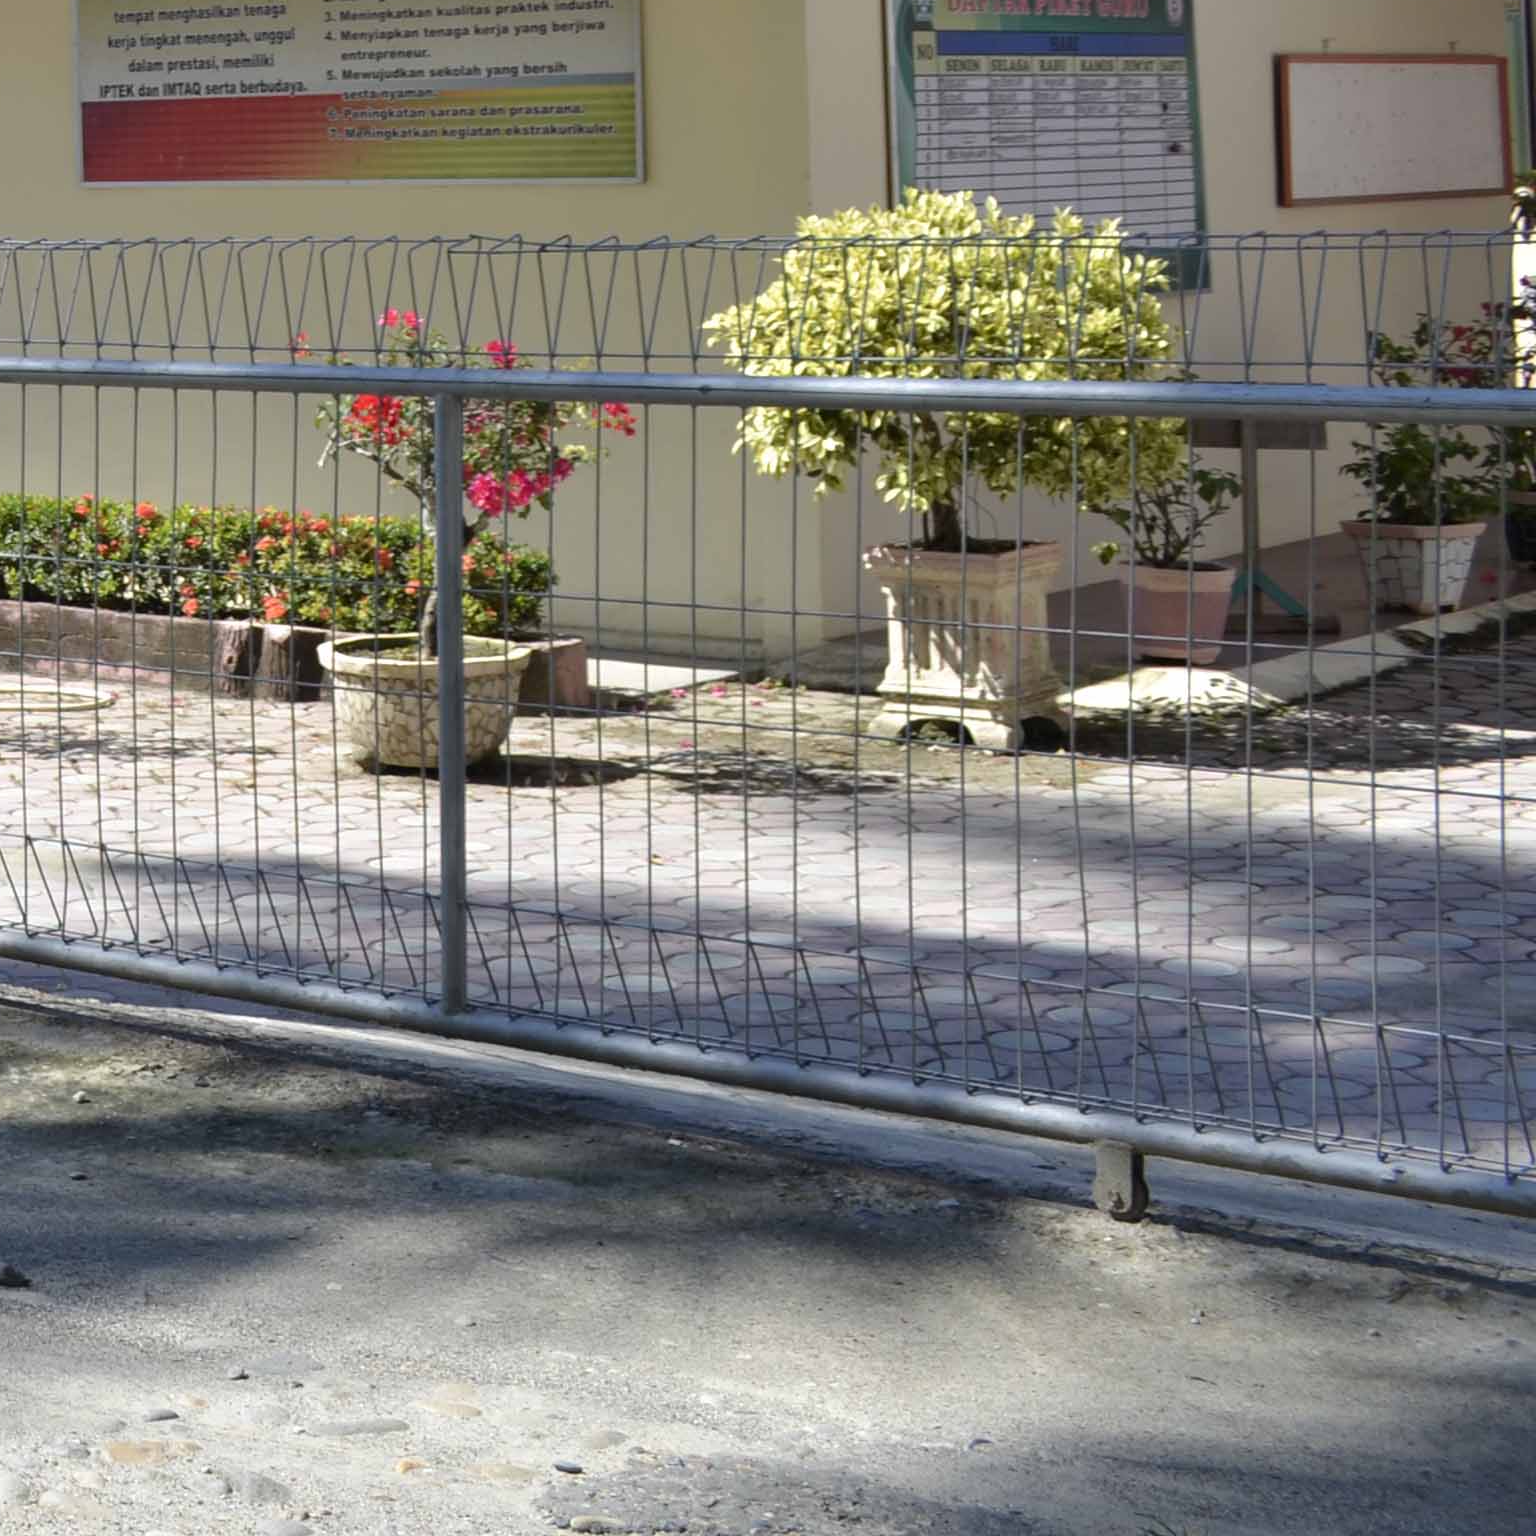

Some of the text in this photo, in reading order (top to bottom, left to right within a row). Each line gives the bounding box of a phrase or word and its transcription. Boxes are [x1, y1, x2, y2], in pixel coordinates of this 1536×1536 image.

[113, 2, 288, 25] tempat menghasilkan tenaga
[339, 7, 433, 24] Meningkatkan
[436, 3, 491, 16] kualitas
[496, 0, 549, 15] praktek
[108, 33, 137, 51] kerja
[139, 30, 182, 50] tingkat
[254, 26, 296, 46] unggul
[340, 27, 419, 43] Menyiapkan
[423, 26, 470, 41] tenaga
[474, 22, 509, 38] kerja
[513, 22, 547, 37] yang
[552, 18, 606, 36] berjiwa
[127, 52, 276, 74] dalam prestasi, memiliki
[341, 47, 431, 62] entrepreneur.
[342, 67, 425, 83] Mewujudkan
[429, 64, 482, 79] sekolah
[485, 64, 519, 78] yang
[522, 61, 568, 75] bersih
[99, 77, 309, 99] IPTEK dan IMTAQ serta berbudaya.
[343, 106, 426, 121] Peningkatan
[430, 106, 476, 117] sarana
[479, 104, 506, 116] dan
[345, 125, 438, 141] Meningkatkan
[441, 126, 501, 140] kegiatan
